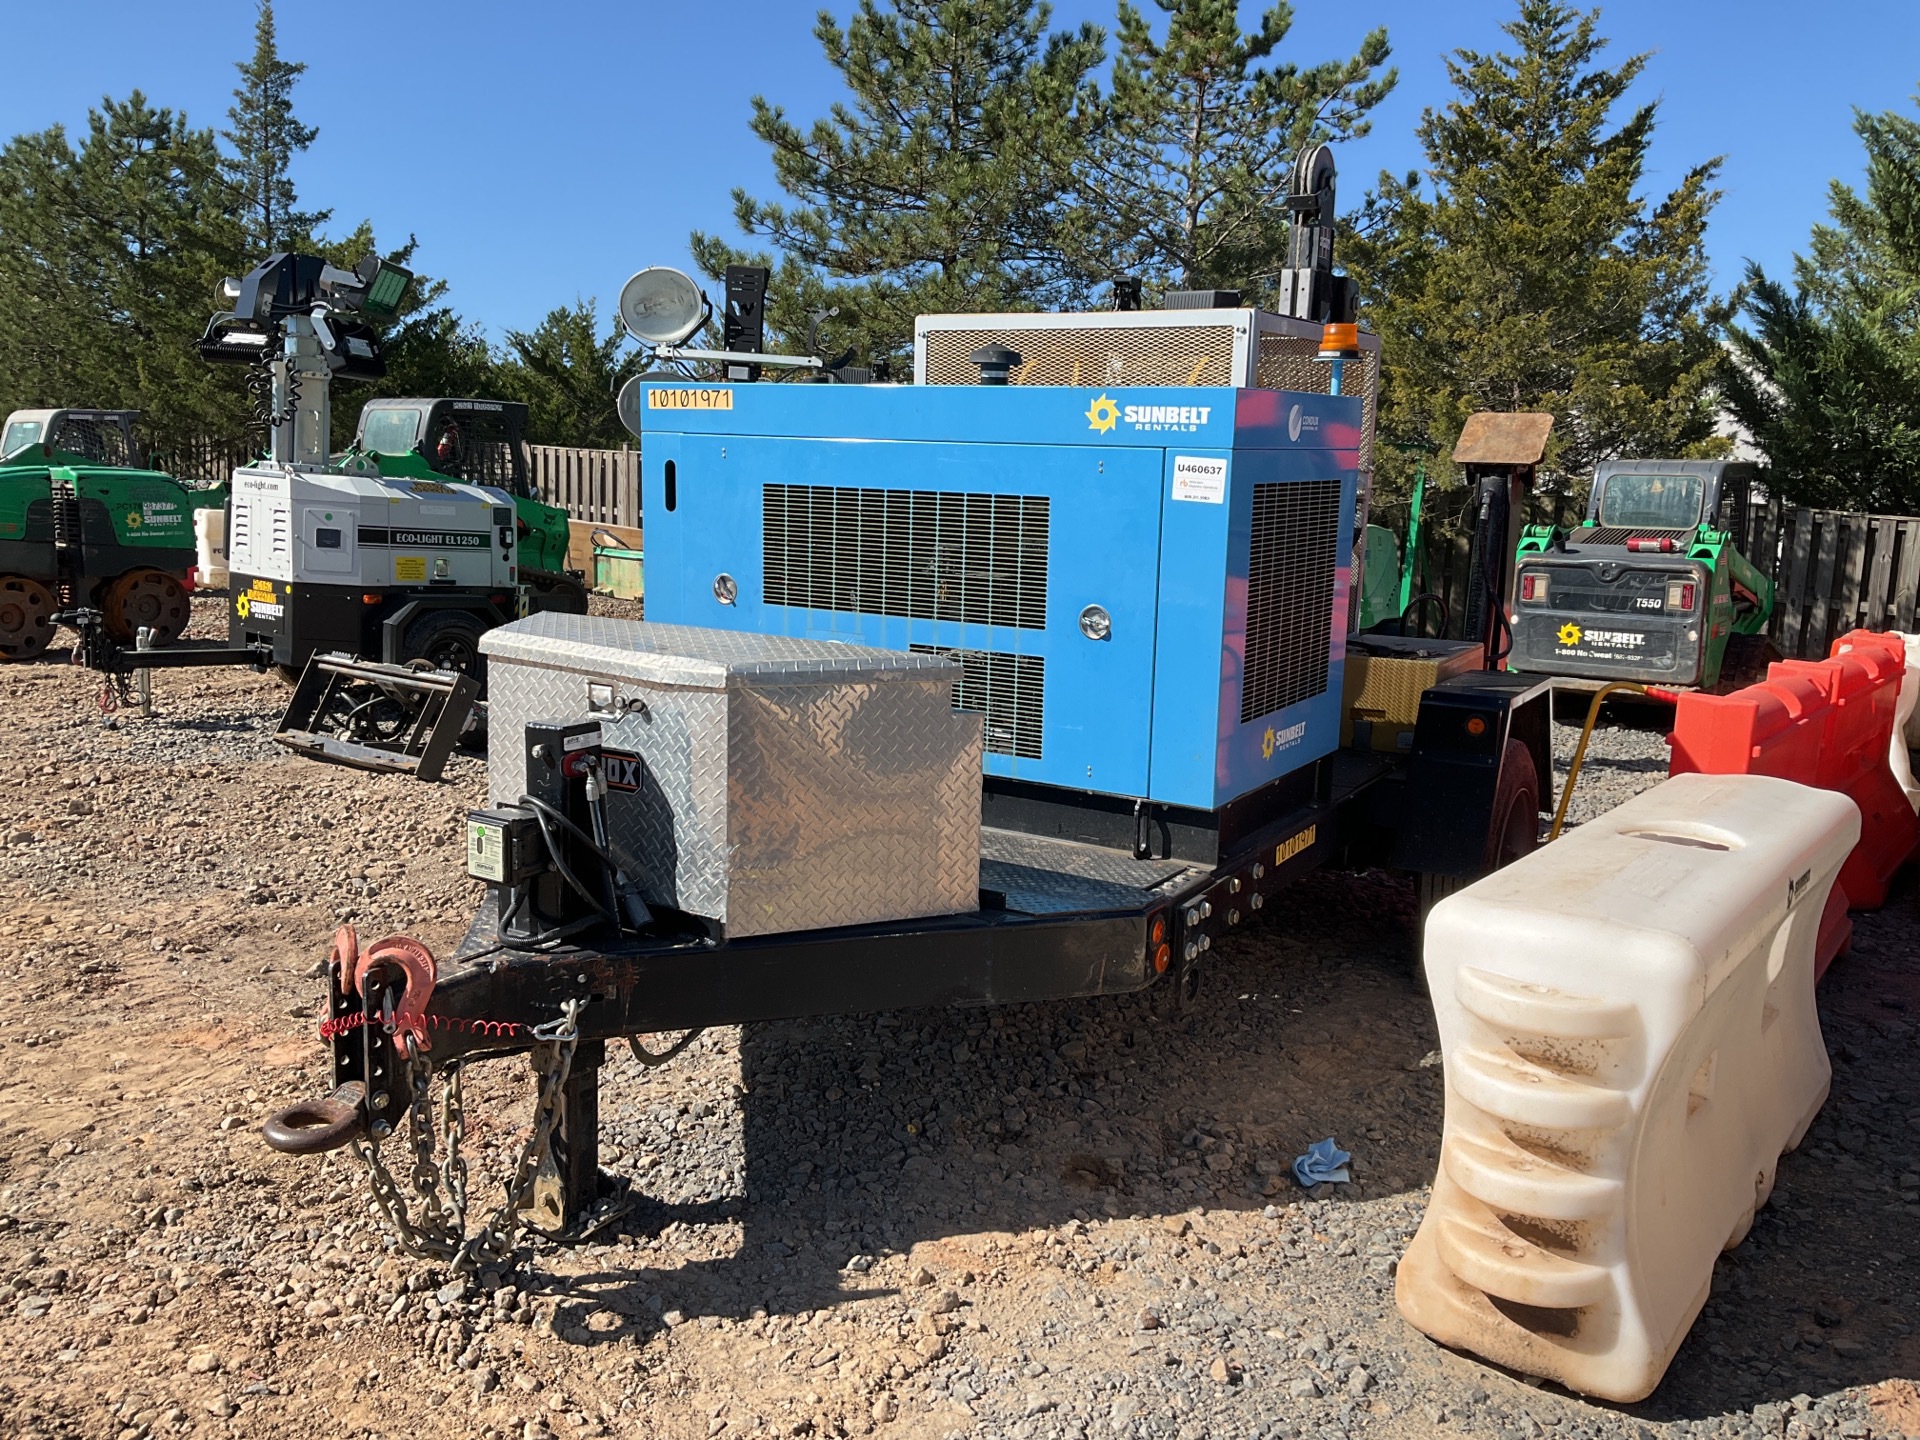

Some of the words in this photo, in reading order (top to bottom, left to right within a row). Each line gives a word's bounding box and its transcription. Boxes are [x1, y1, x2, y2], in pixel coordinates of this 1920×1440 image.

[650, 389, 729, 408] 10101971
[1124, 405, 1211, 425] SUNBELT
[1135, 423, 1197, 432] RENTALS
[1177, 464, 1222, 475] U460637
[244, 481, 279, 491] eco-light.com
[143, 514, 183, 524] SUNBELT
[396, 533, 443, 545] ECO-LIGHT
[445, 536, 480, 546] EL1250
[250, 600, 285, 617] SUNBELT
[1636, 598, 1662, 609] T550
[1584, 629, 1645, 645] SUNBELT
[1554, 648, 1576, 656] 1-800
[1275, 721, 1307, 747] SUNBELT
[1279, 737, 1302, 751] RENTALS
[1278, 826, 1315, 863] 10101971
